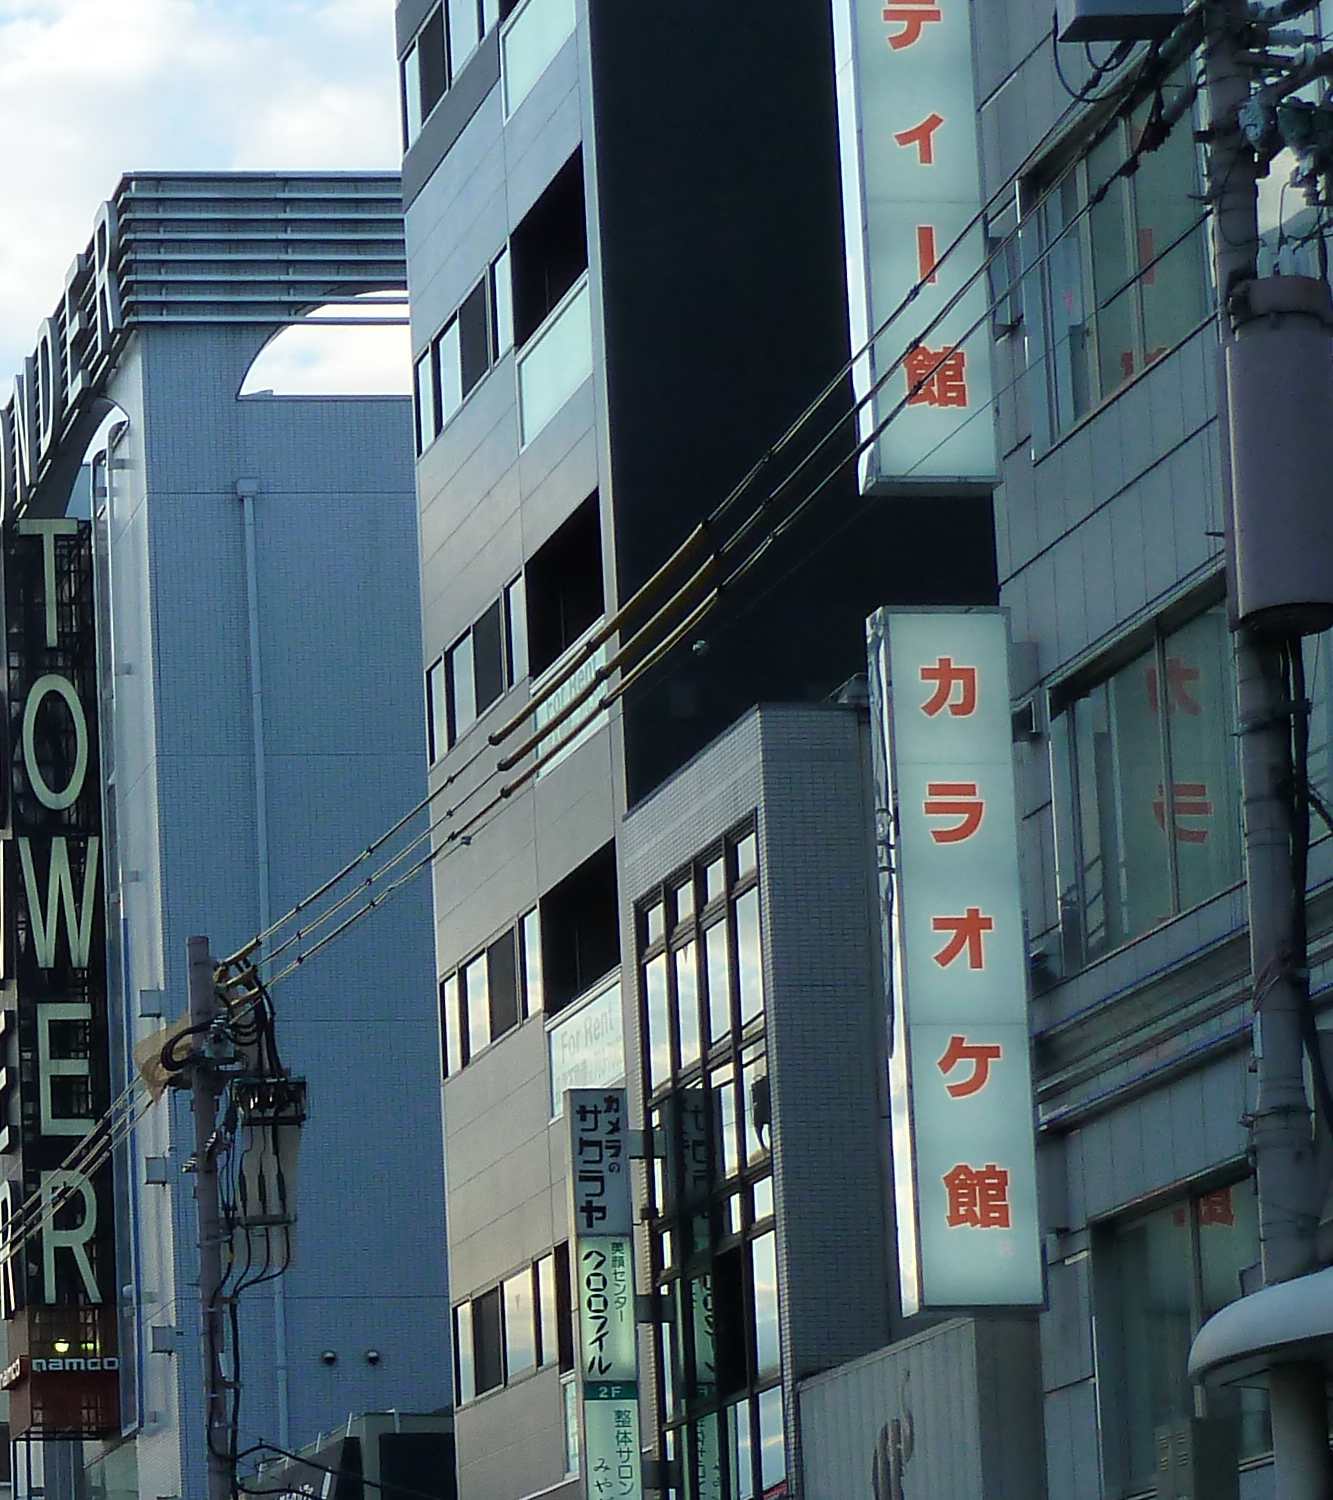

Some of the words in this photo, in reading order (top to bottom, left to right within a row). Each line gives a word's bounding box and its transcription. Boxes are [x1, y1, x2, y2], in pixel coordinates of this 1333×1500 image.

[18, 518, 103, 1304] TOWER
[919, 656, 1012, 1230] カラオケ館
[560, 1029, 581, 1064] For
[584, 1001, 614, 1048] Rent
[575, 1103, 608, 1229] サクラヤ
[603, 1094, 623, 1173] カメラの
[32, 1357, 120, 1372] namco
[597, 1386, 622, 1399] 2F
[613, 1409, 634, 1496] 整体サロン
